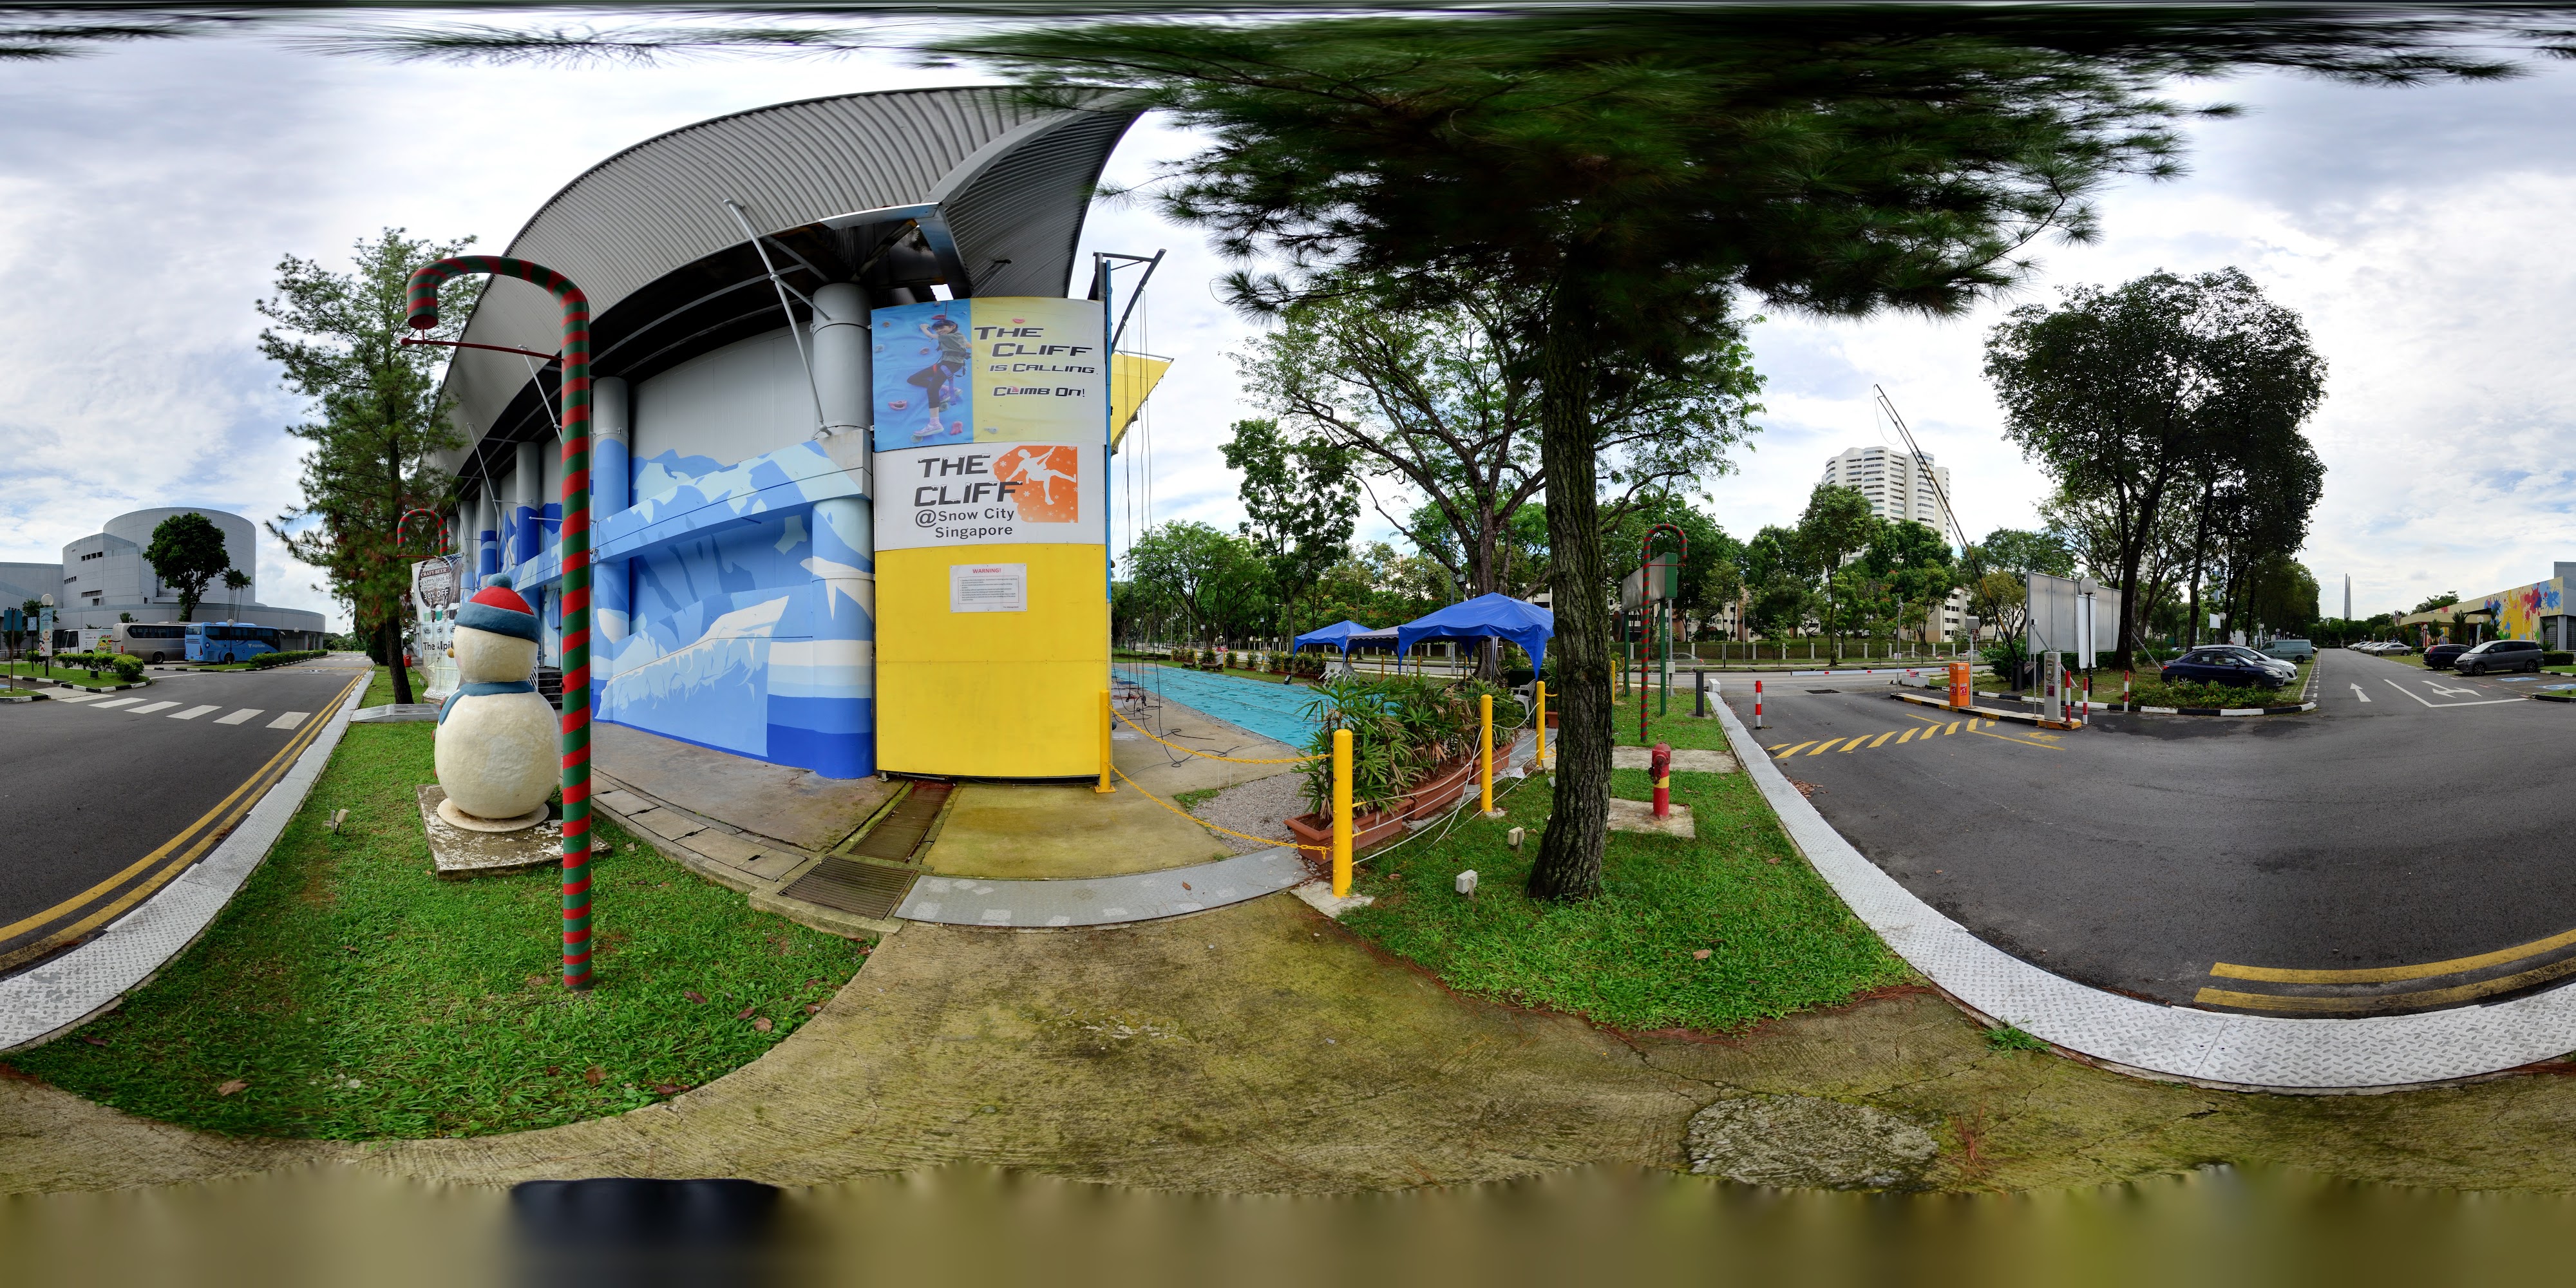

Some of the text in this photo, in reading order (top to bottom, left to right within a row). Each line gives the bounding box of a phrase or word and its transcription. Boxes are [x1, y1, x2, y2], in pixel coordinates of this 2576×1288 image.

[974, 327, 1044, 340] THE
[992, 343, 1093, 357] CLIFF
[917, 453, 991, 478] THE
[914, 480, 1023, 507] CLIFF
[984, 507, 1014, 521] City
[935, 526, 1013, 540] Singapore
[424, 591, 435, 600] 30%
[422, 641, 450, 651] The Alpi
